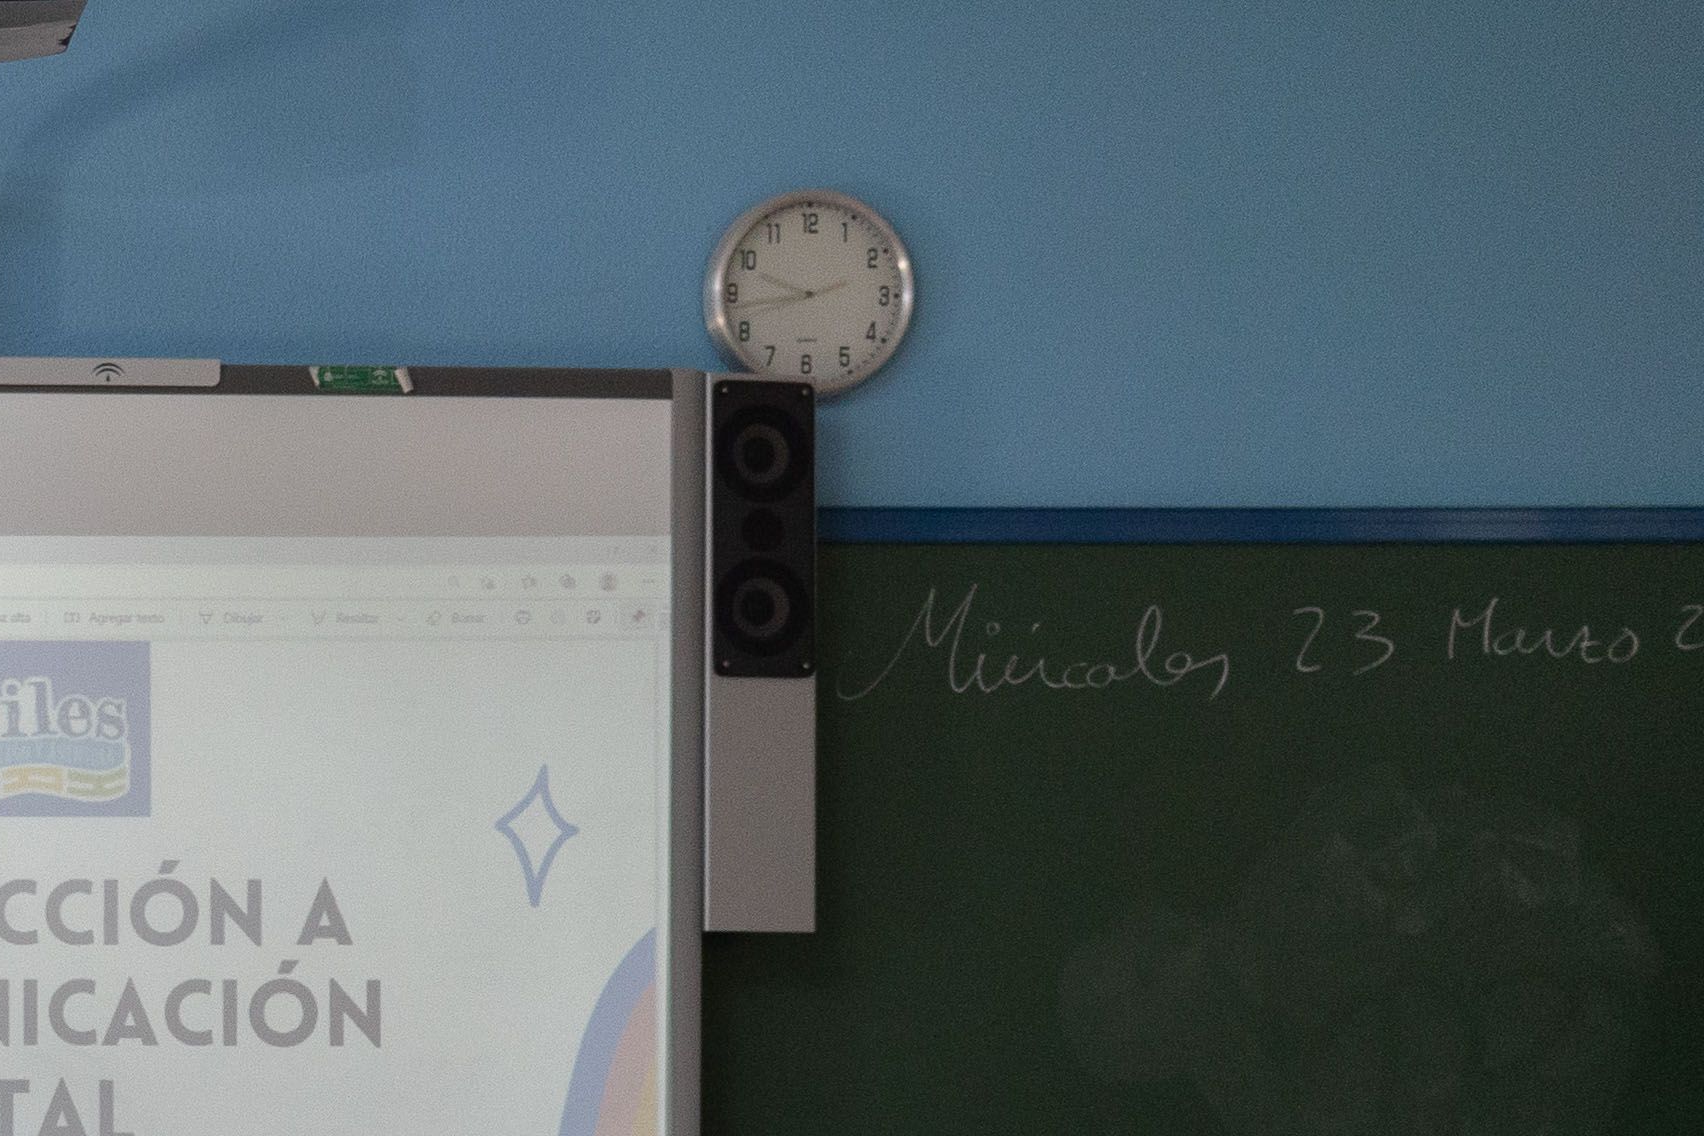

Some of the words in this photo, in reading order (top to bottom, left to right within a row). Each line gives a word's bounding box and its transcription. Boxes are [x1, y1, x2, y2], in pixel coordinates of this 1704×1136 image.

[767, 223, 781, 244] 11
[800, 213, 819, 234] 12
[841, 222, 848, 243] 1
[740, 250, 757, 270] 10
[867, 248, 878, 268] 2
[727, 283, 738, 303] 9
[878, 286, 890, 306] 3
[738, 321, 750, 342] 8
[866, 322, 877, 340] 4
[764, 345, 776, 366] 7
[801, 354, 812, 374] 6
[839, 346, 850, 367] 5
[10, 611, 32, 623] alta
[89, 611, 132, 626] Agregar
[1293, 606, 1395, 676] 23
[296, 877, 353, 946] A
